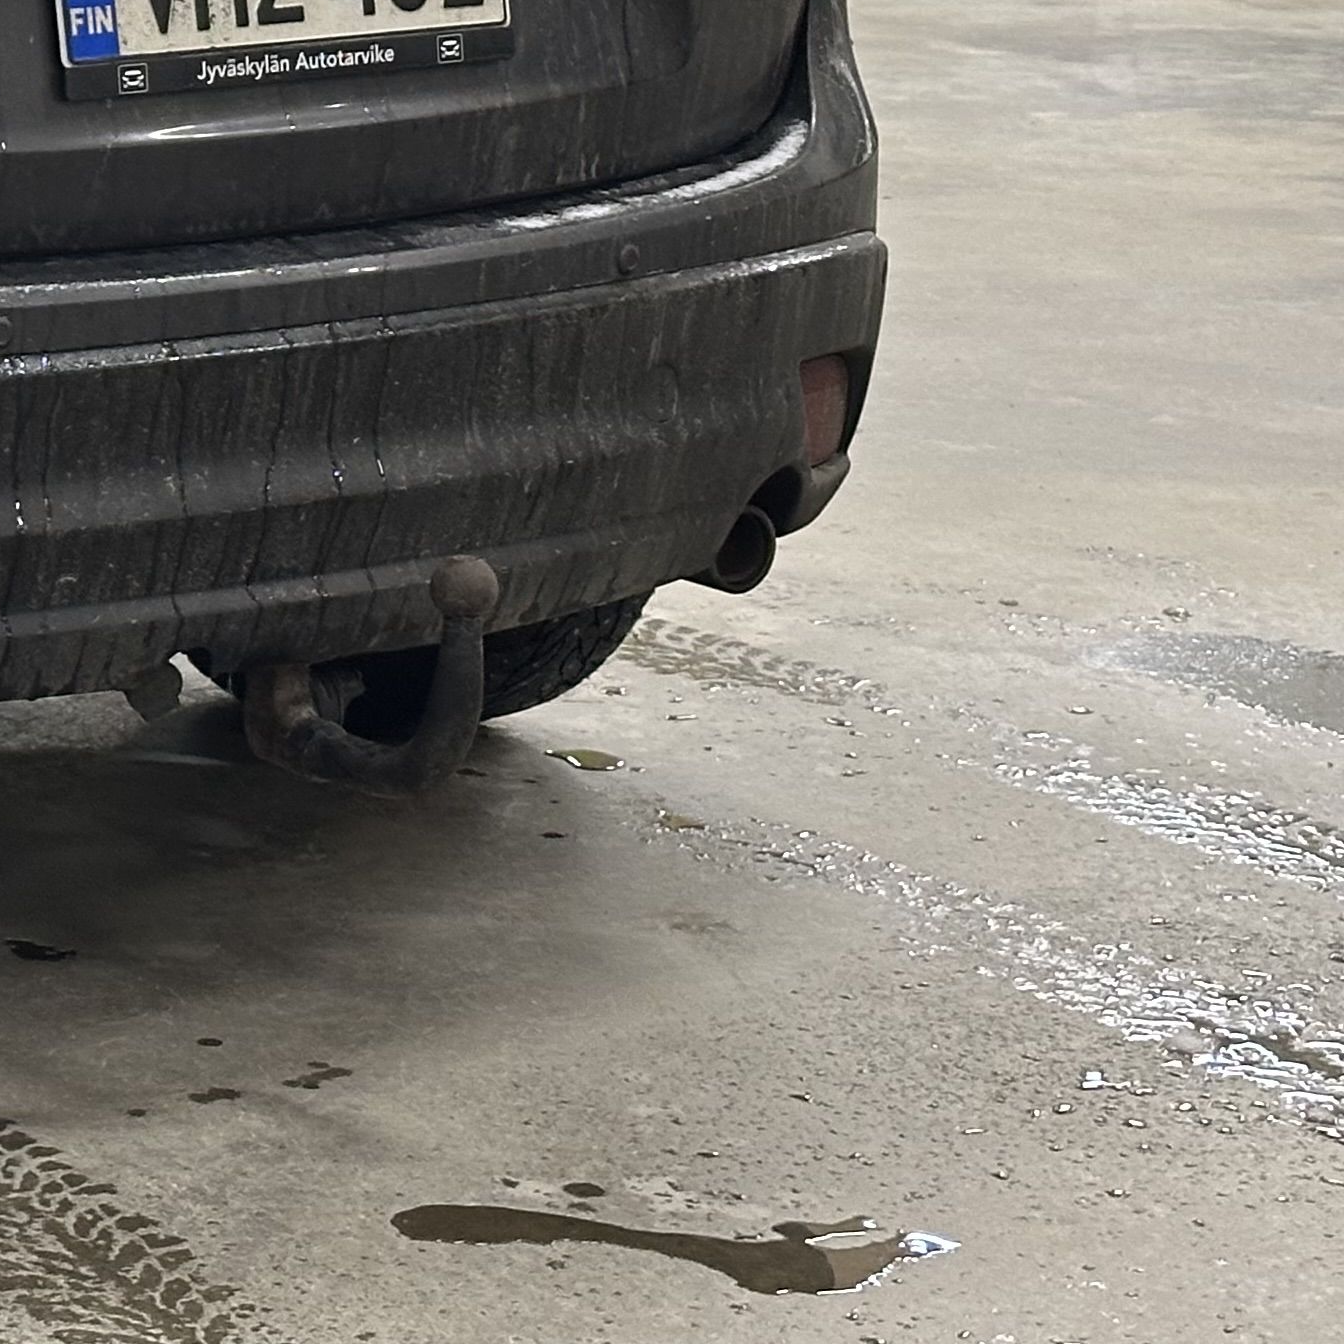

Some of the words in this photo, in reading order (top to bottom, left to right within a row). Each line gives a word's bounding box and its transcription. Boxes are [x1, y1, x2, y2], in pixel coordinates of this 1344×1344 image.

[69, 4, 114, 36] FIN
[197, 54, 291, 85] Jyväskylän
[295, 43, 395, 71] Autotarvike
